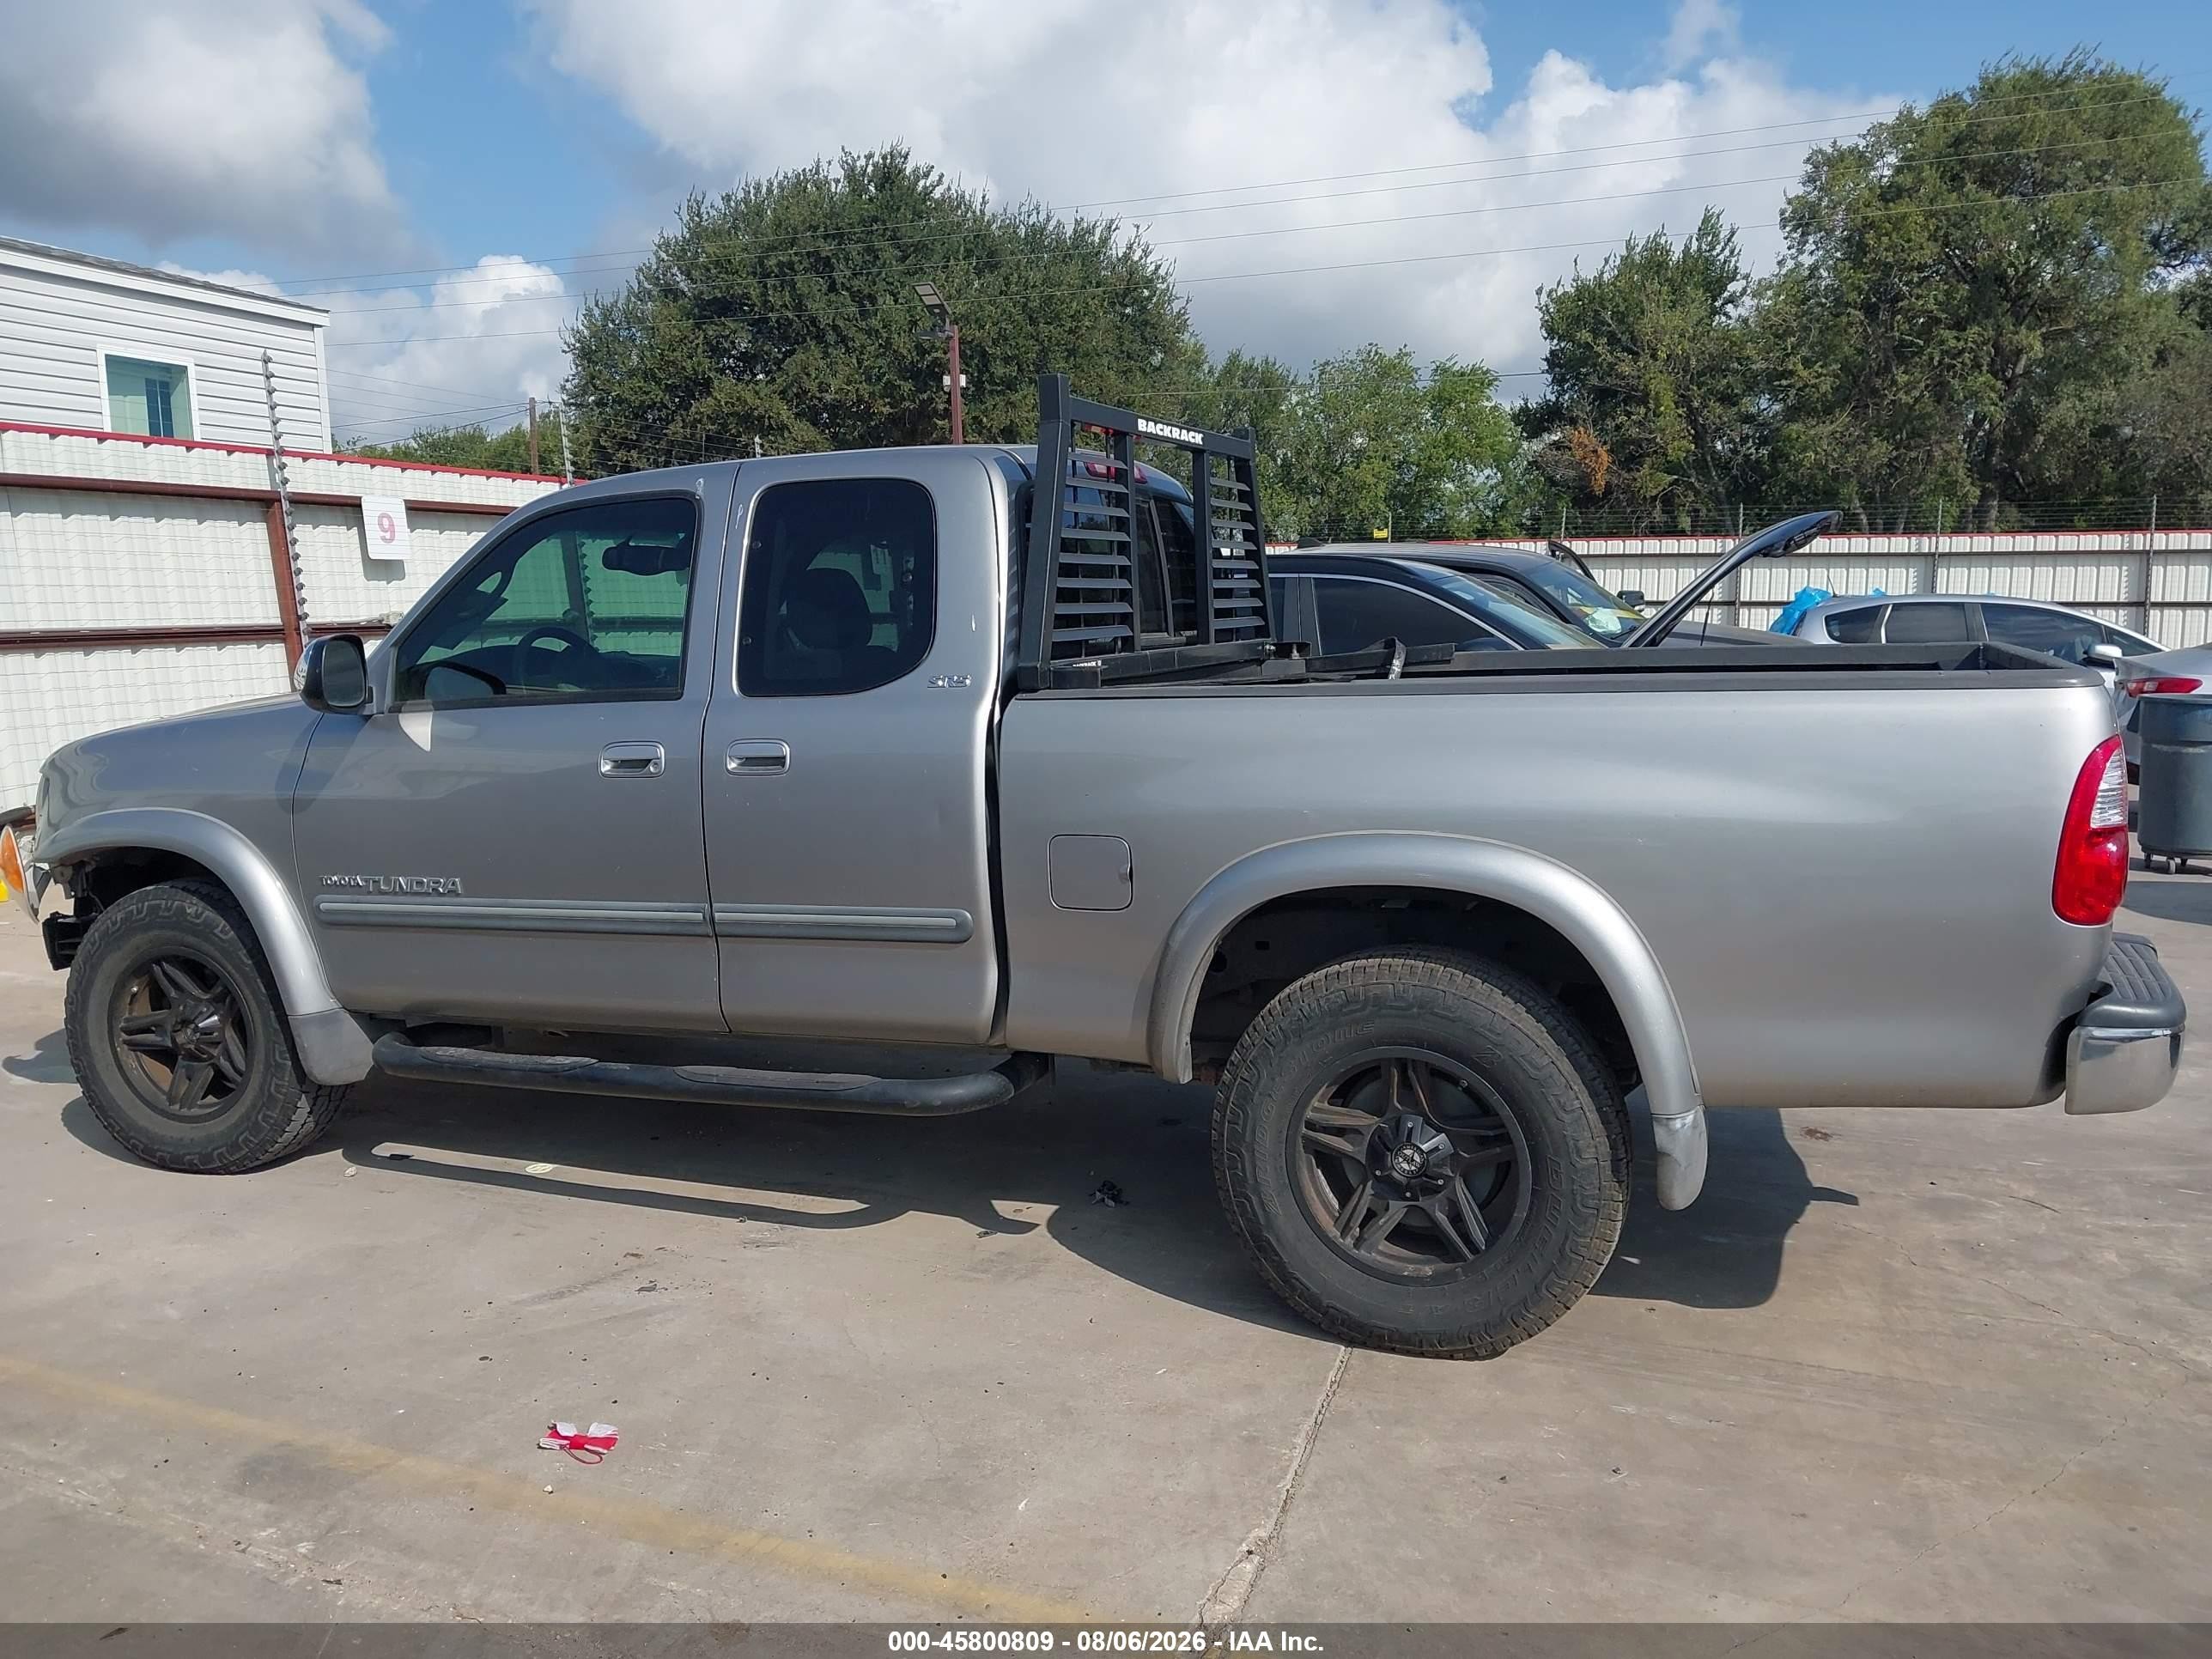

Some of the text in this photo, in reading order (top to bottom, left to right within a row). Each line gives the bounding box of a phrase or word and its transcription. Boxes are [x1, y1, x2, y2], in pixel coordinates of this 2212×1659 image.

[1137, 417, 1205, 445] BACKRACK
[377, 512, 396, 544] 9
[319, 874, 463, 894] TOYOTA TUNDRA
